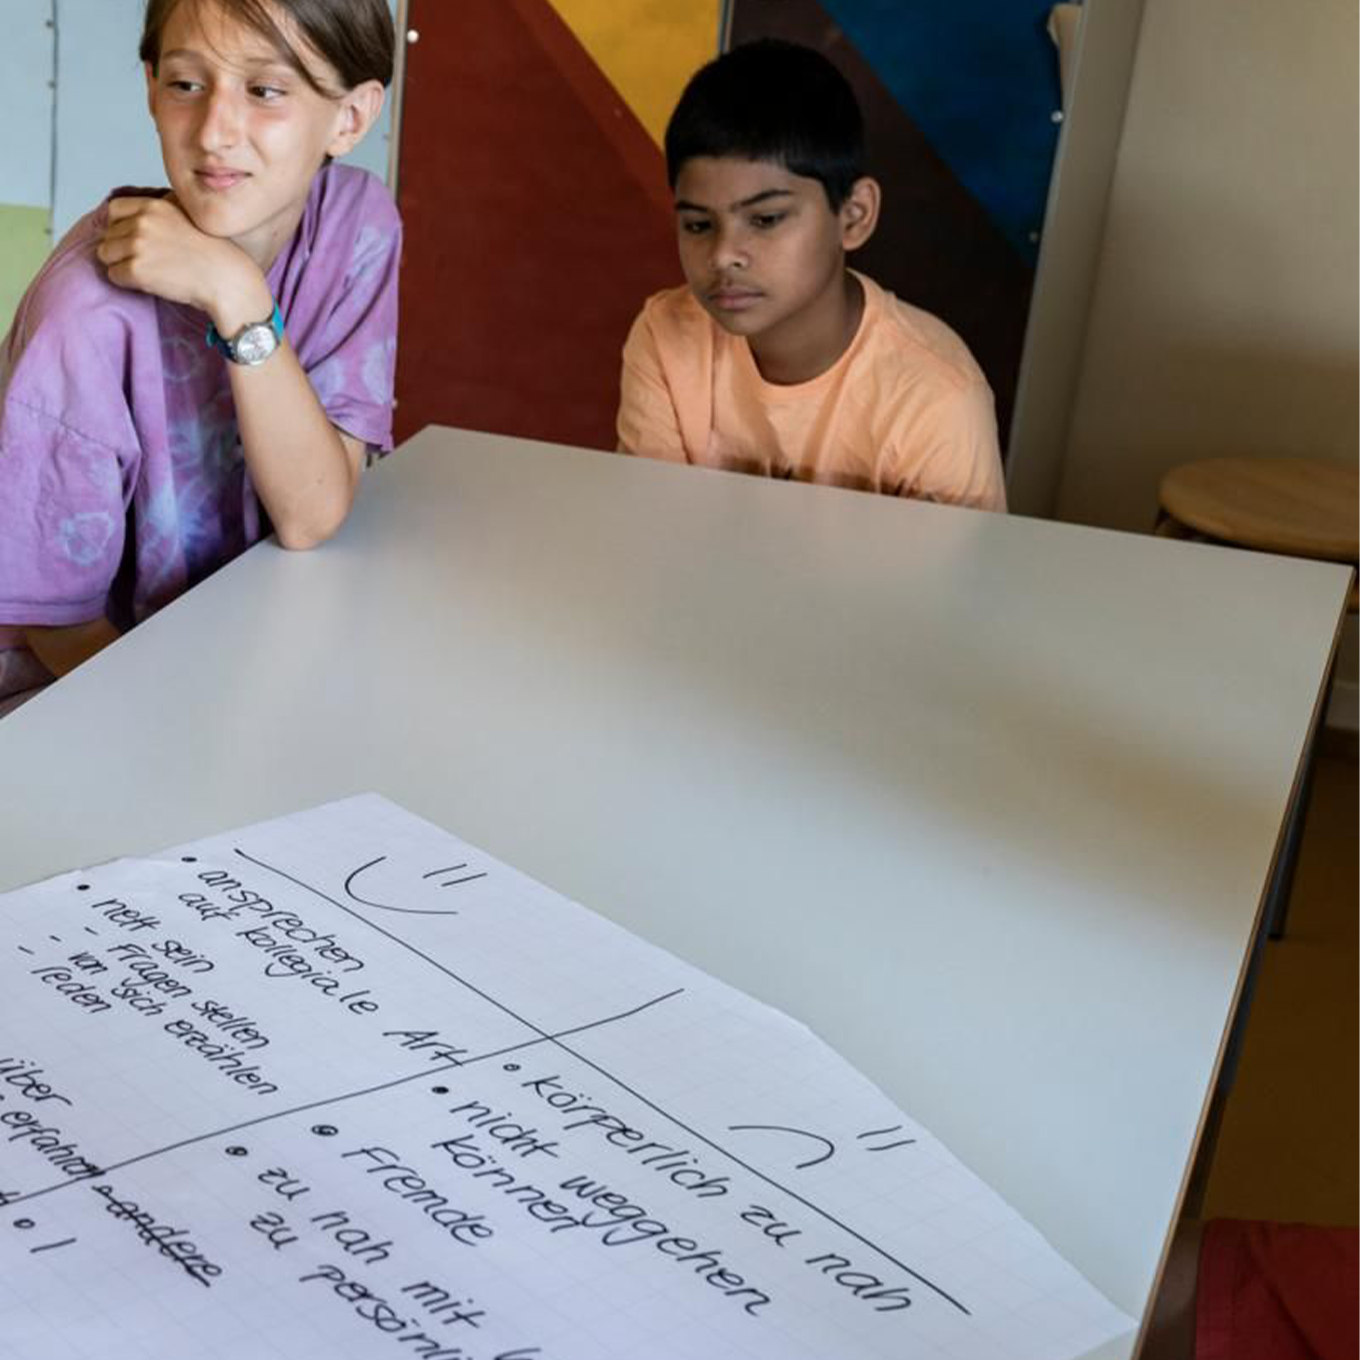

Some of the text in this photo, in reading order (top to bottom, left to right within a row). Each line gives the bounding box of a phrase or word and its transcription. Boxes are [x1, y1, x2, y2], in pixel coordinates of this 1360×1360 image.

[91, 898, 215, 974] nett sein
[196, 868, 366, 974] ansprechen
[30, 965, 113, 1014] reden
[67, 951, 279, 1097] von sich erzählen
[106, 943, 271, 1051] Fragen stellen
[177, 891, 466, 1068] auf kollegiale Art
[248, 1210, 299, 1251] zu
[340, 1146, 494, 1248] Fremde
[430, 1133, 583, 1234] können
[448, 1099, 772, 1317] nicht weggehen
[522, 1074, 913, 1313] körperlich zu nah
[256, 1166, 486, 1329] zu nah mit
